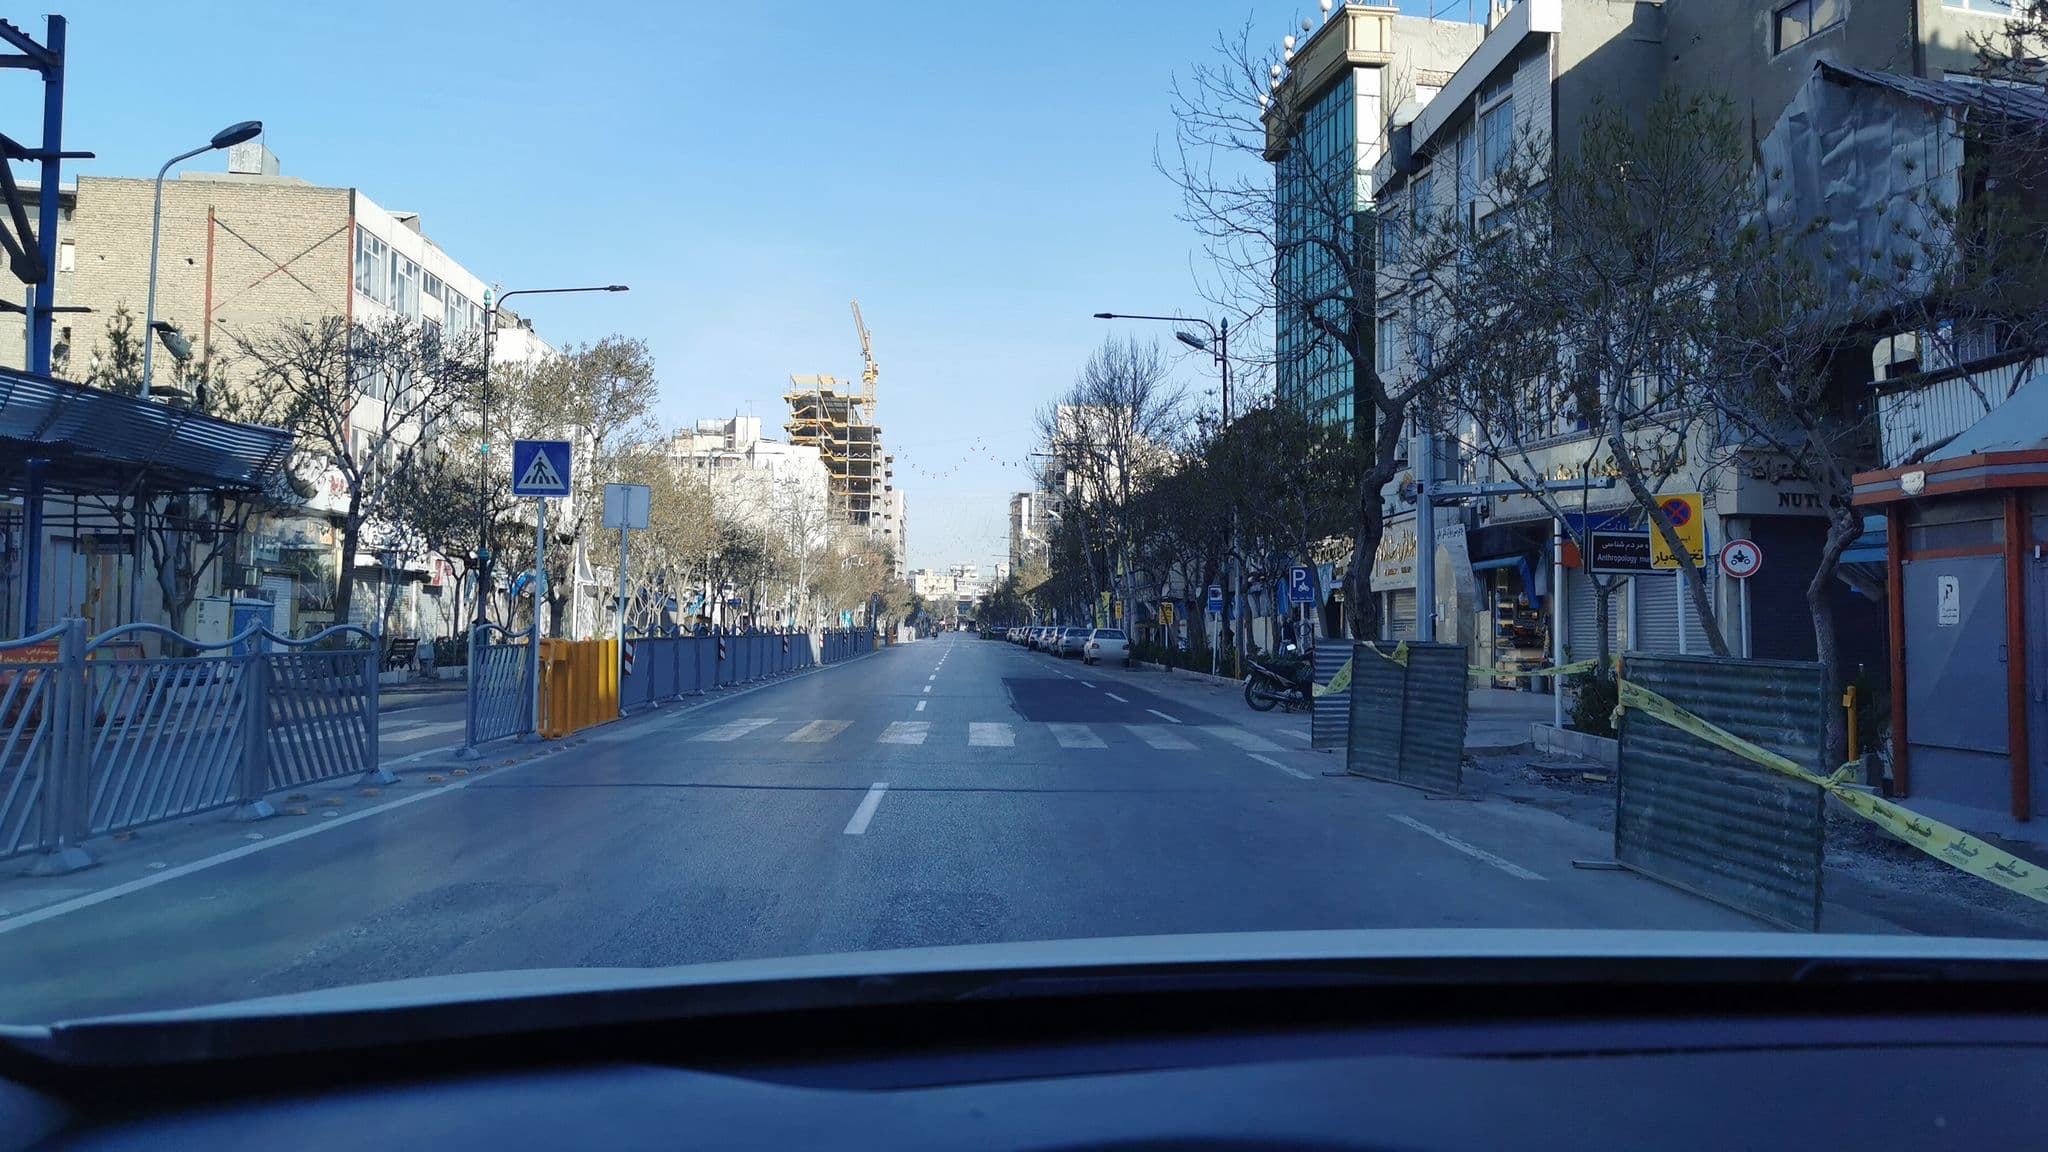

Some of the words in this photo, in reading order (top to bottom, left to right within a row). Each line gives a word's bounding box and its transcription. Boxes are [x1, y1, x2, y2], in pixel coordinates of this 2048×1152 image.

[1601, 540, 1625, 550] شناسی
[1597, 553, 1638, 564] Anthropology
[1653, 552, 1668, 566] بار
[1292, 569, 1306, 588] P
